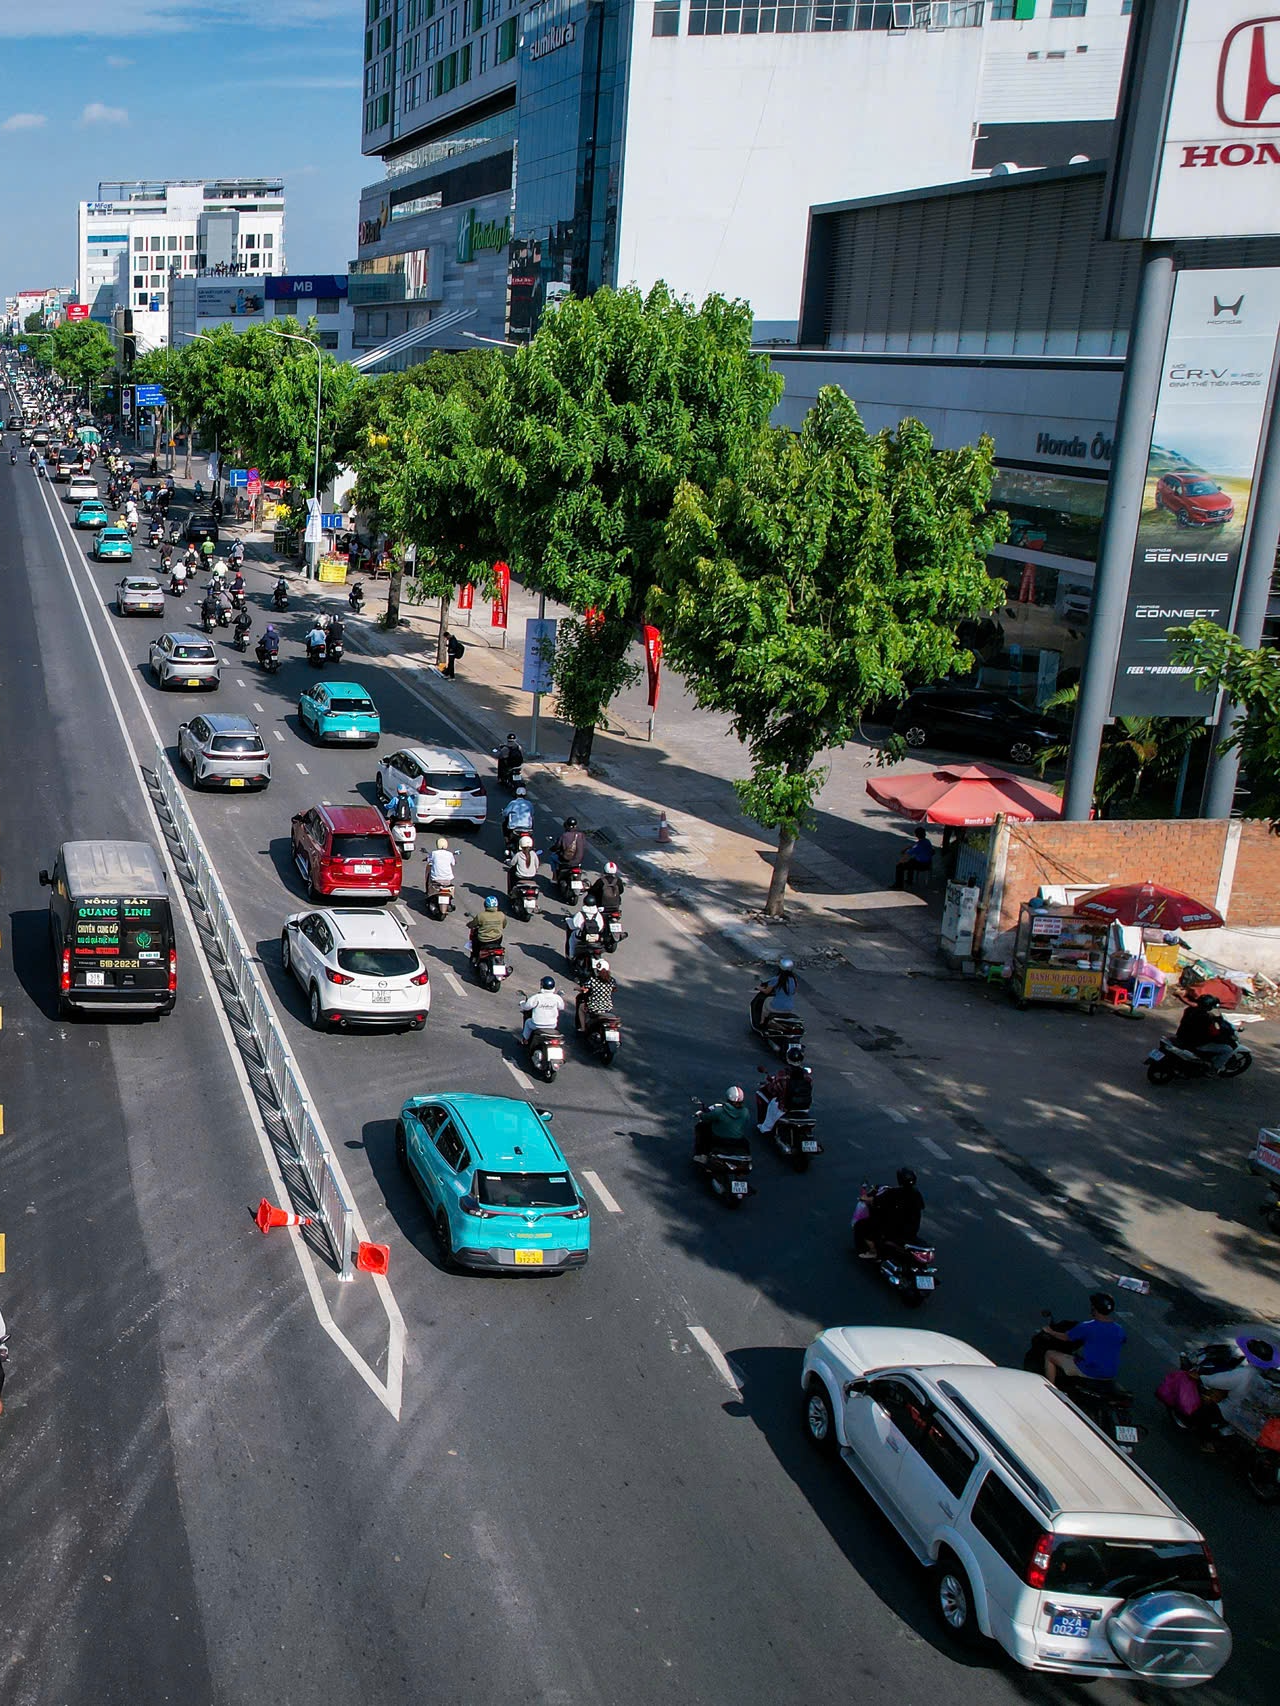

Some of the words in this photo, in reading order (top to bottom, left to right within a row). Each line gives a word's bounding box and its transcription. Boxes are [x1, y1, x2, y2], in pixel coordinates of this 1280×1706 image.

[293, 281, 313, 292] MB
[1170, 368, 1228, 380] CR-V
[1036, 432, 1087, 458] Honda
[1090, 432, 1112, 460] Ôt
[1144, 552, 1229, 562] SENSING
[1136, 609, 1220, 618] CONNECT
[1126, 666, 1144, 674] FEEL
[78, 908, 118, 917] QUANG
[124, 908, 151, 916] LINH
